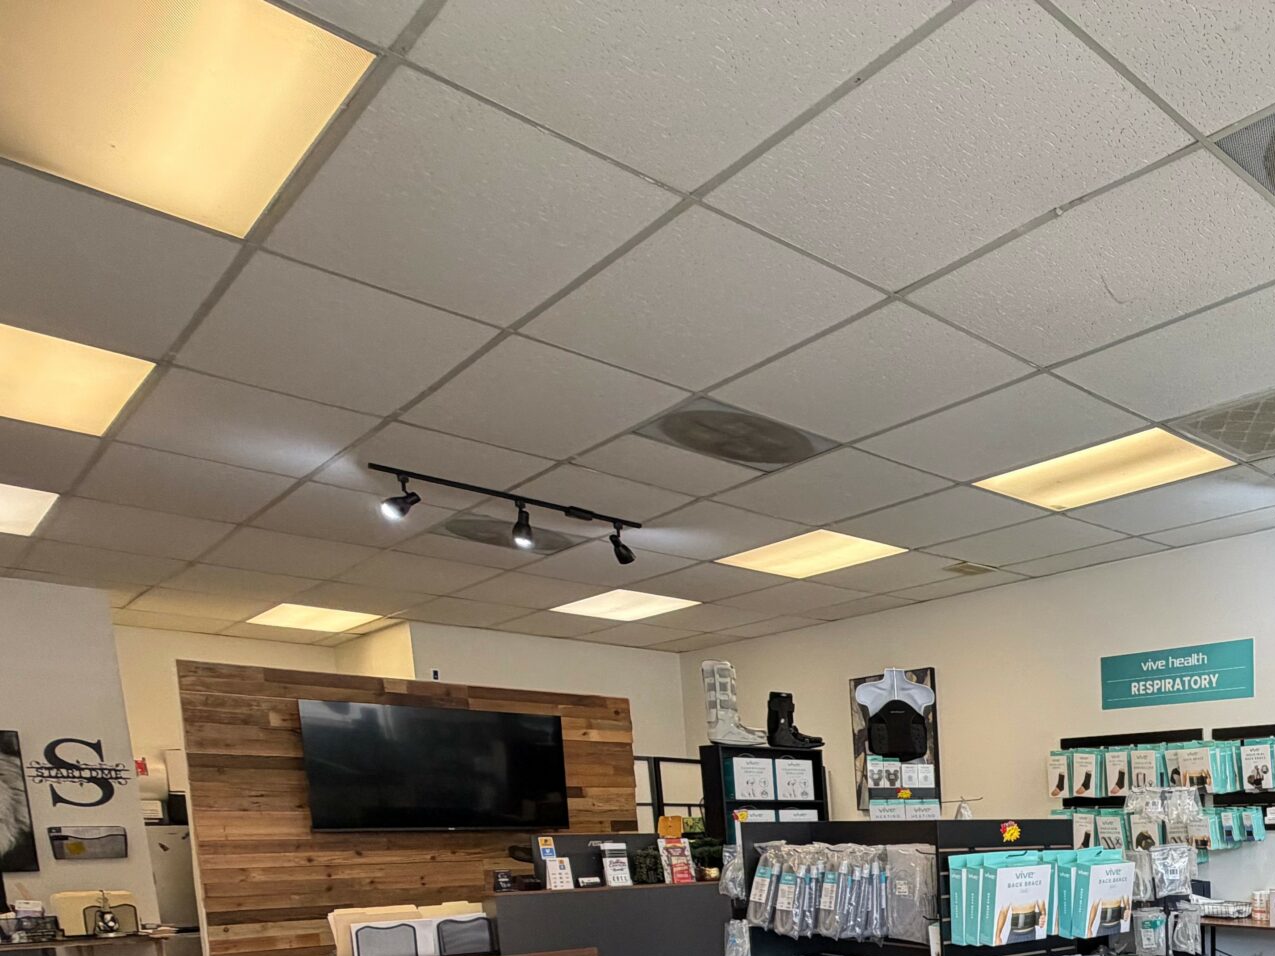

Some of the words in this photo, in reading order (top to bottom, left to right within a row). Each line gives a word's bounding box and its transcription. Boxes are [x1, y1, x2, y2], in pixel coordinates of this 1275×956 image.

[1141, 656, 1166, 672] vive
[1168, 652, 1208, 668] health
[1131, 673, 1219, 696] RESPIRATORY
[43, 737, 115, 808] S
[1015, 870, 1035, 880] vive
[1105, 868, 1123, 877] vive
[1022, 880, 1043, 888] BRACE
